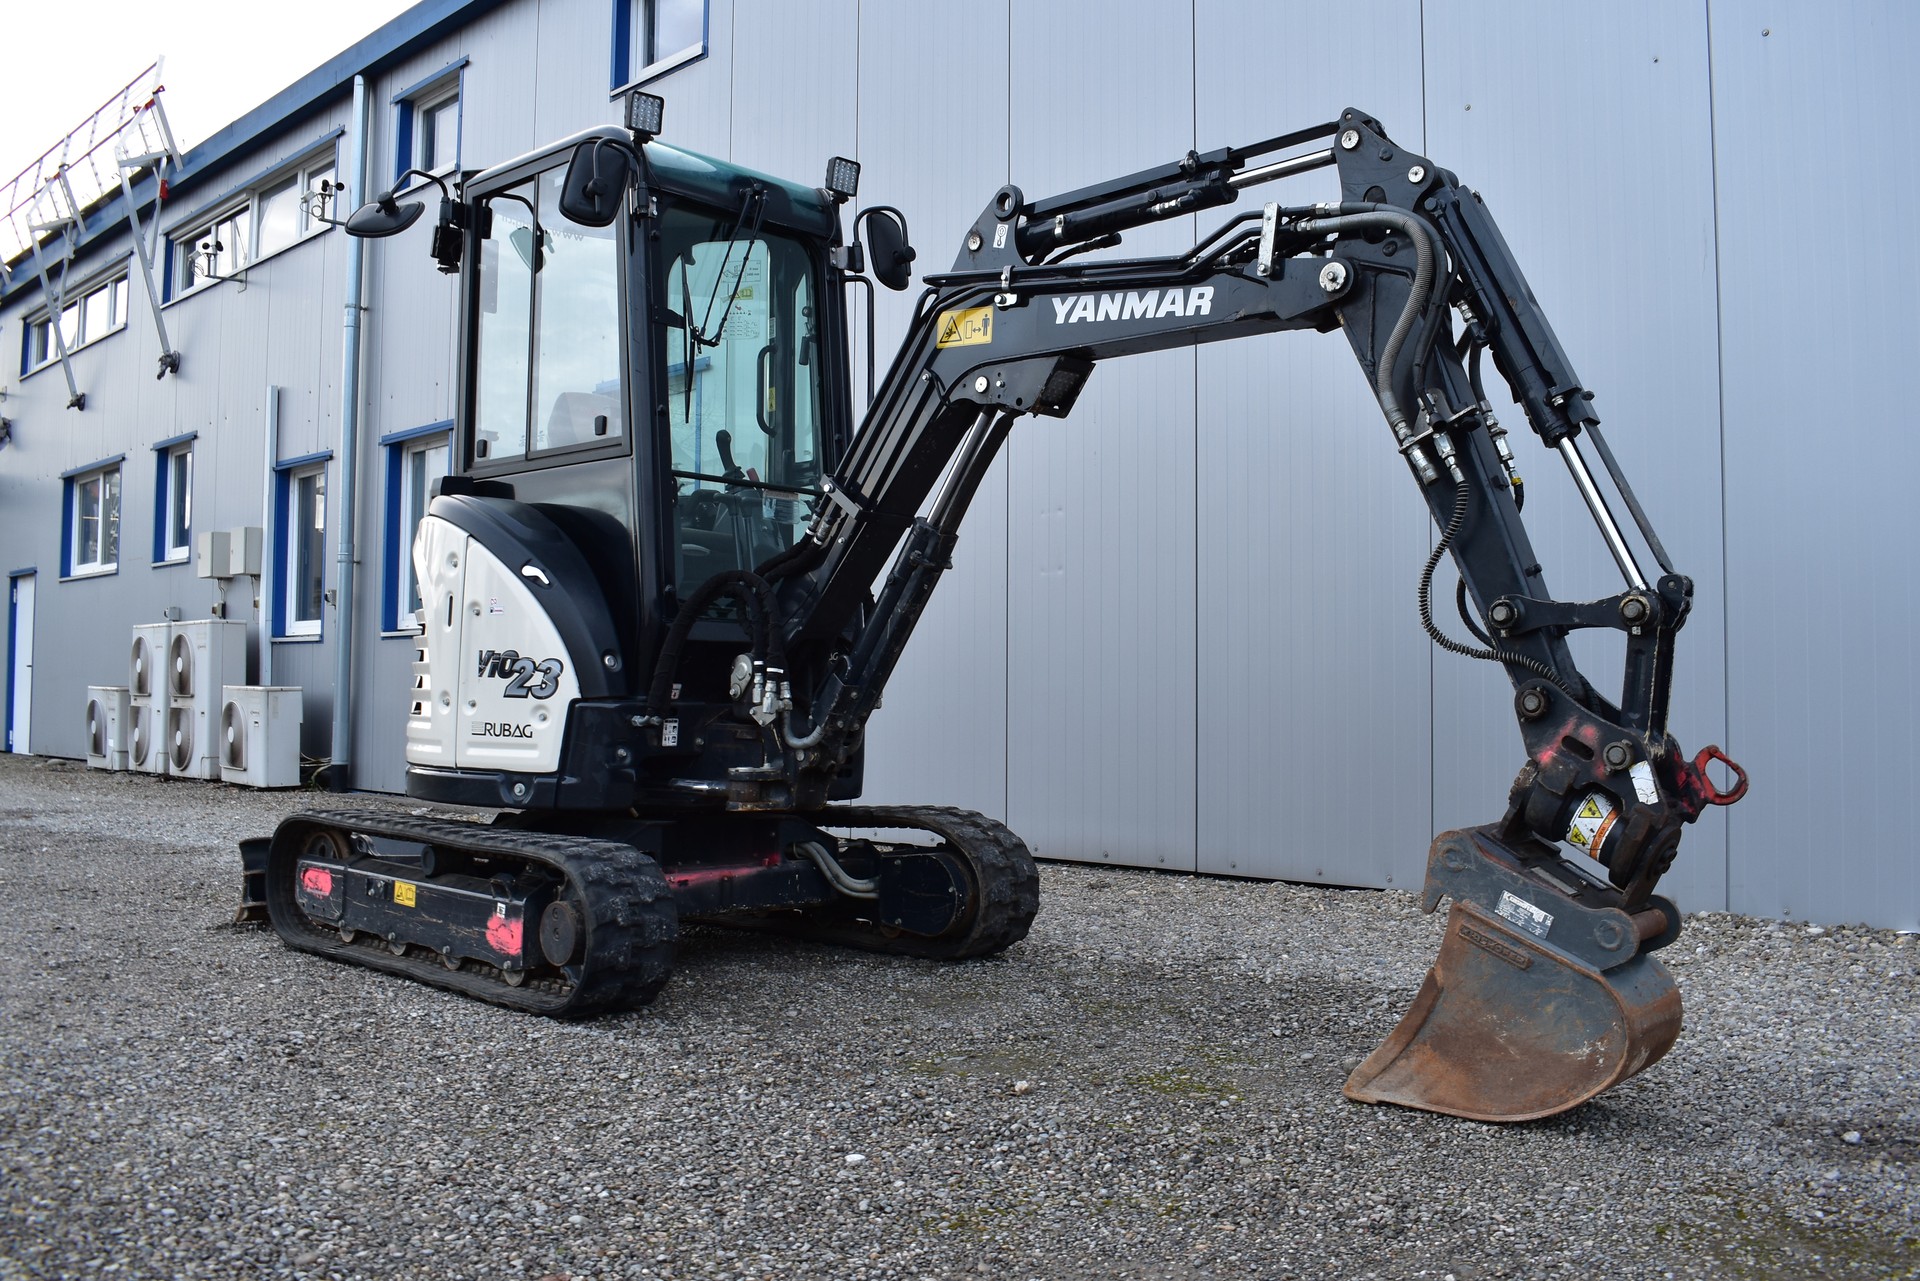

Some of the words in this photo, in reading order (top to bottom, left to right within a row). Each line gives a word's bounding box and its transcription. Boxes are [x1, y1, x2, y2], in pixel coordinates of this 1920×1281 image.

[1051, 286, 1214, 324] YANMAR
[503, 657, 564, 700] 23
[473, 722, 533, 738] RUBAG
